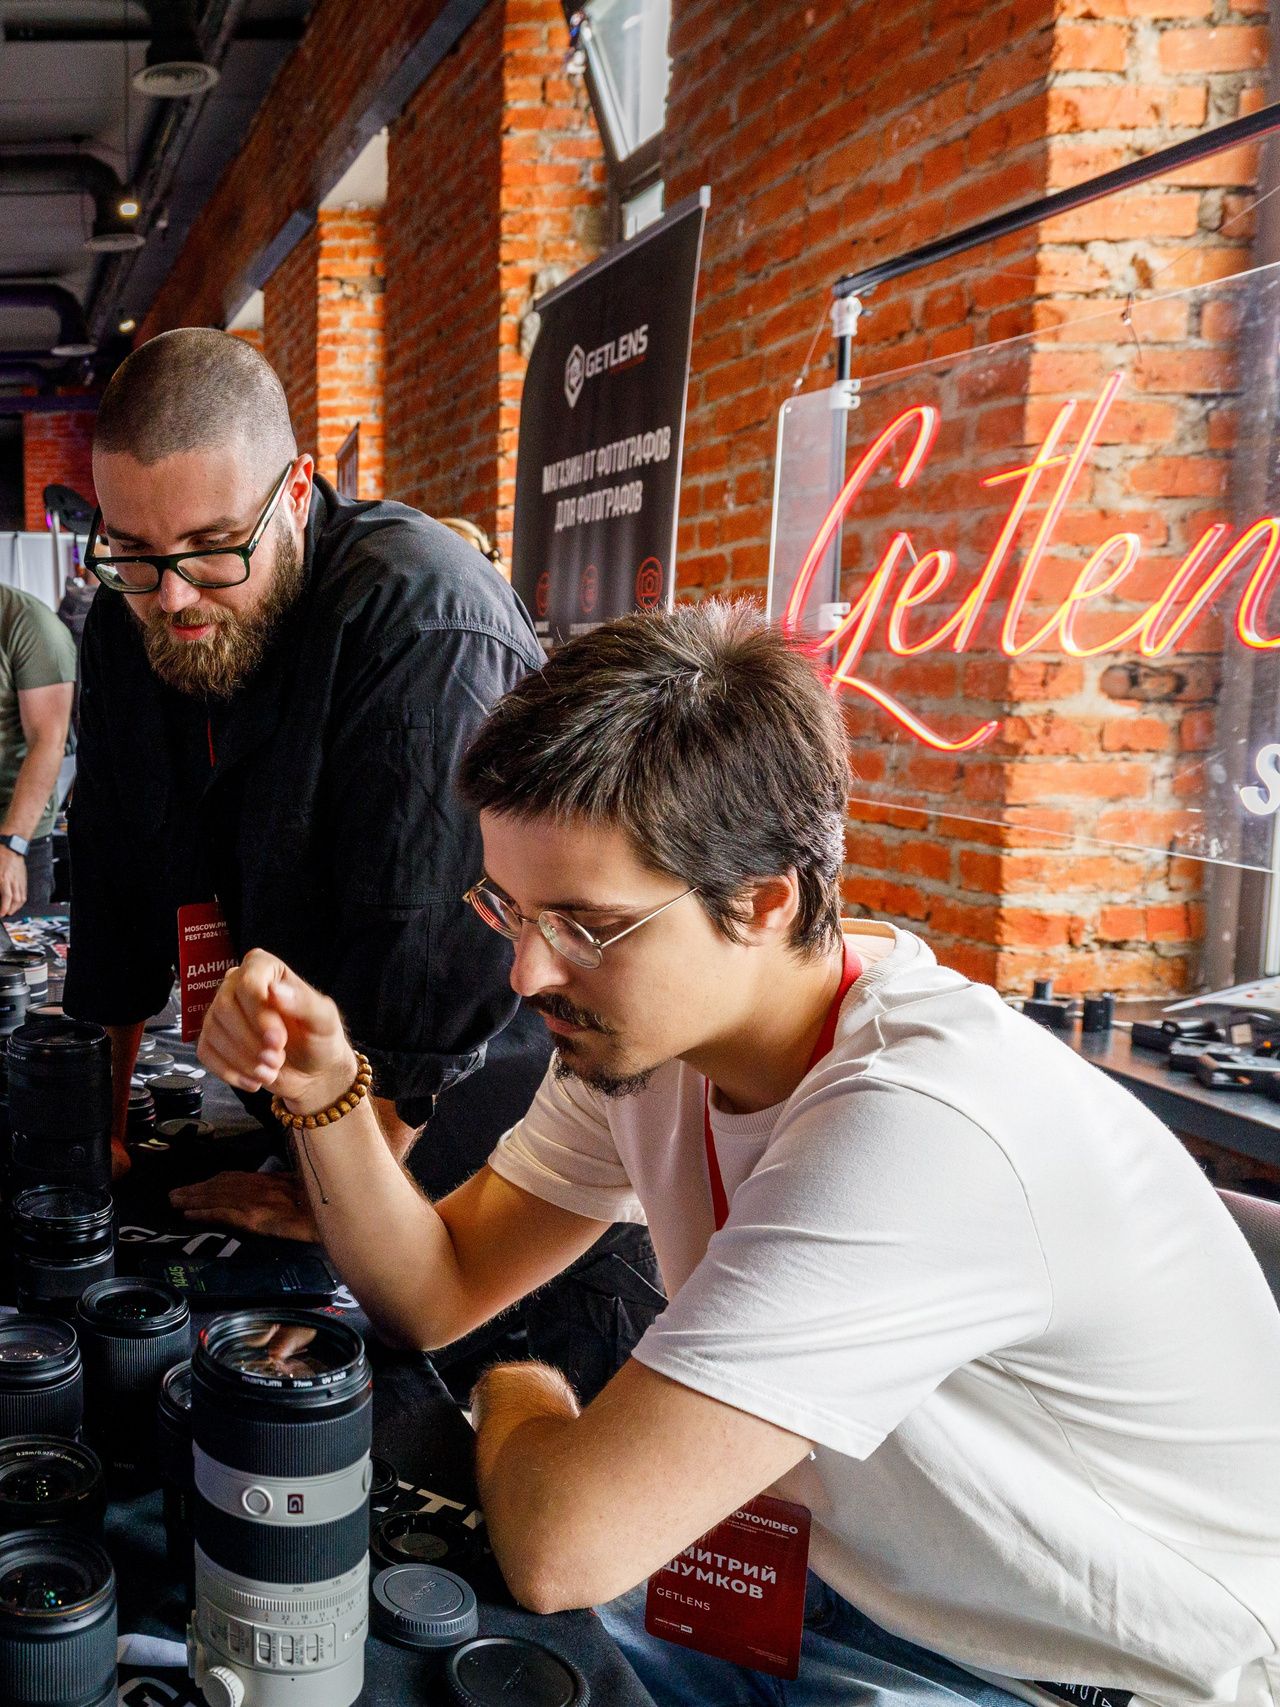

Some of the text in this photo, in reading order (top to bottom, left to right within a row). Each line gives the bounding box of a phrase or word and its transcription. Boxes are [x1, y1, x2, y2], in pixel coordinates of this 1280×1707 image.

[585, 324, 649, 378] GETLENS
[541, 425, 671, 494] МАГАЗИН ОТ ФОТОГРАФОВ
[554, 479, 643, 532] ДЛЯ ФОТОГРАФОВ
[185, 933, 201, 941] FEST
[202, 930, 218, 939] 2024
[187, 978, 223, 992] РОЖДЕС
[730, 1511, 799, 1535] OTOVIDEO
[680, 1546, 777, 1585] МИТРИЙ
[656, 1587, 710, 1611] GETLENS
